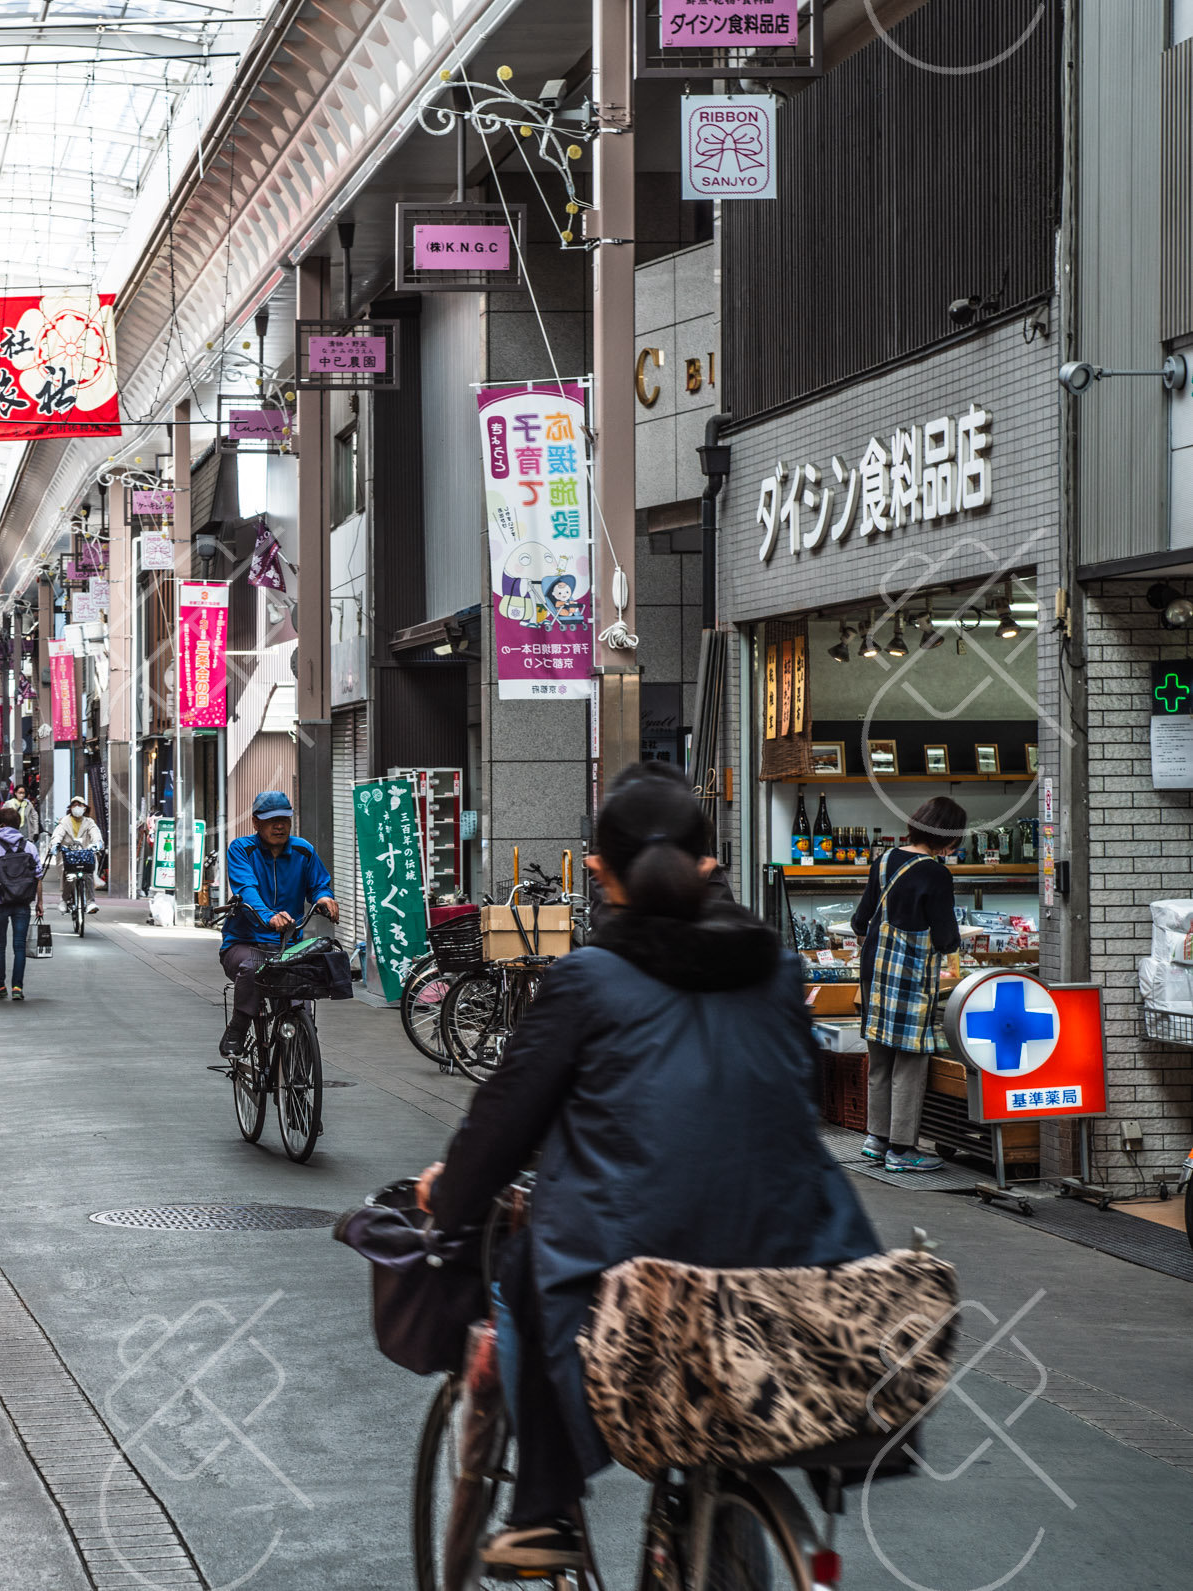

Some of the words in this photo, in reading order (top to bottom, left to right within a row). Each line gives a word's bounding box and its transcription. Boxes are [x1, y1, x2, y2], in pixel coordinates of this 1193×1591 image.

[670, 13, 790, 35] ダイシン食料品店
[699, 111, 759, 123] RIBBON
[702, 176, 757, 187] SANJYO
[757, 403, 993, 562] ダイシン食料品店
[400, 812, 417, 882] 三百年の伝統
[1011, 1088, 1078, 1108] 基準薬局
